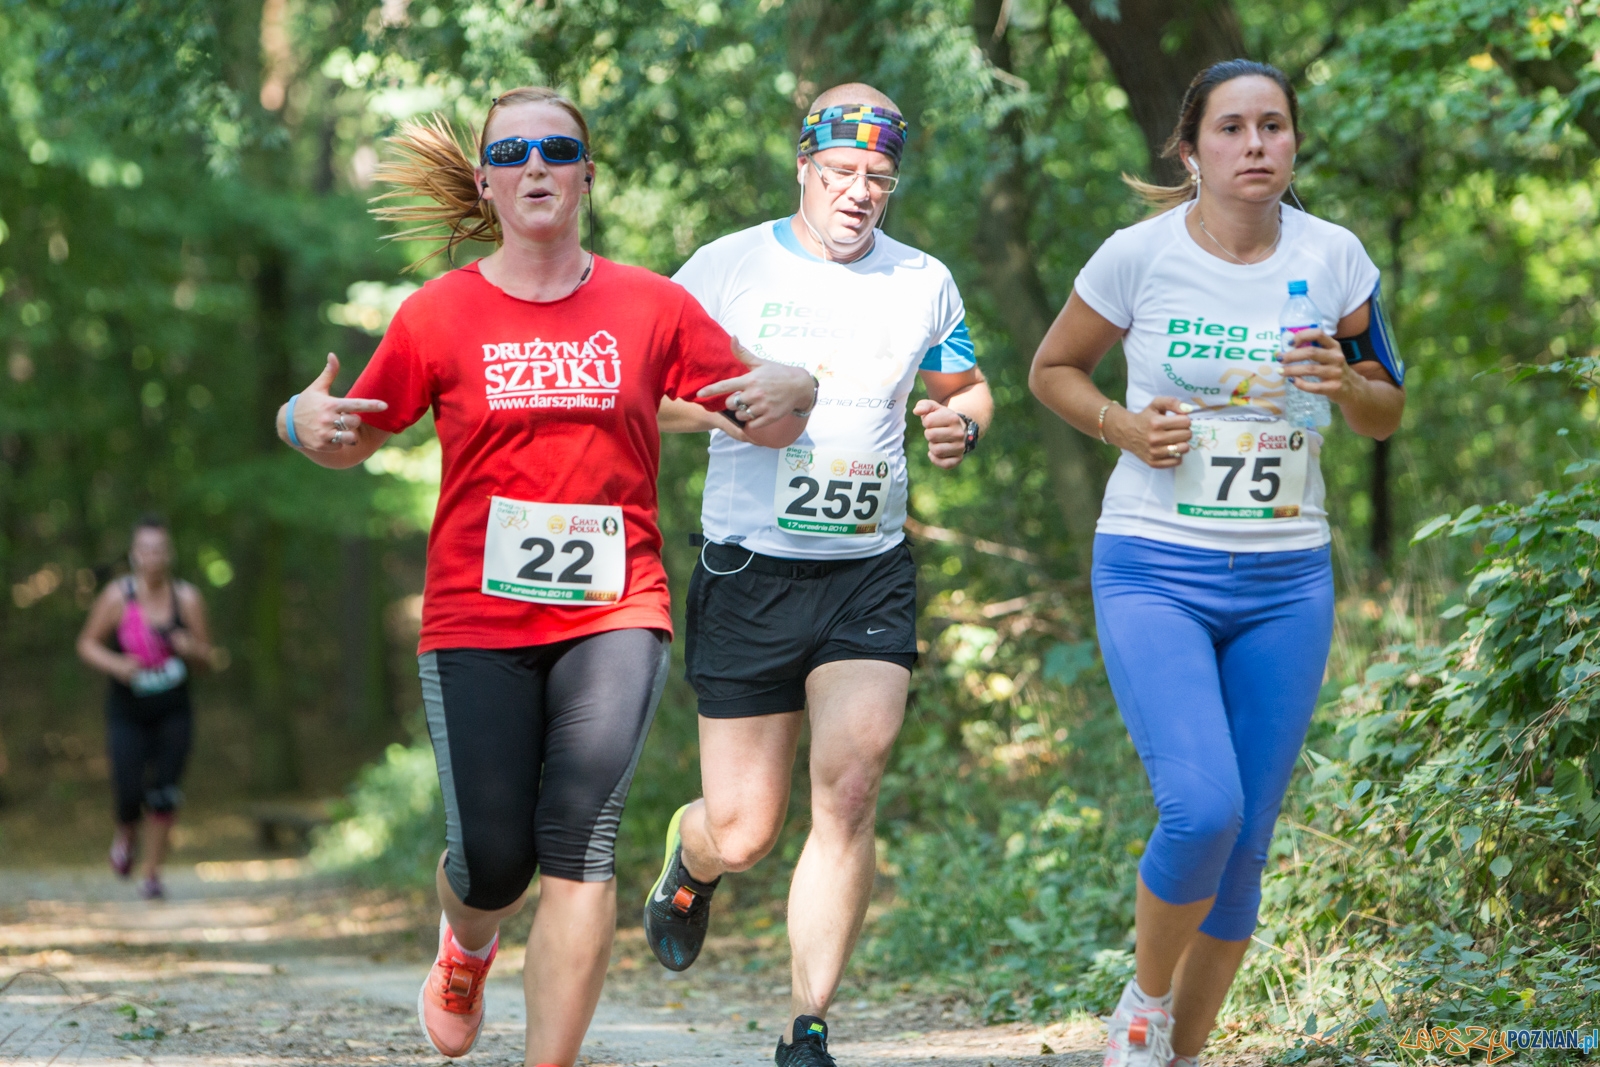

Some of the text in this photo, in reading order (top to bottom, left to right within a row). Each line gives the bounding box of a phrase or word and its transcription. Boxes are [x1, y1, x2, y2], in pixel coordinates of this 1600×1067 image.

[1167, 317, 1249, 342] Bieg
[482, 337, 598, 361] DRUŻYNA
[1167, 340, 1281, 362] Dzieci
[485, 359, 622, 395] SZPIKU
[1161, 363, 1220, 395] Roberta
[488, 394, 615, 411] www.darszpiku.pl
[856, 398, 896, 410] 2016
[849, 469, 875, 477] POLSKA
[1211, 456, 1281, 502] 75
[785, 475, 882, 520] 255
[569, 525, 601, 535] POLSKA
[571, 516, 599, 526] CHATA
[517, 537, 594, 584] 22
[499, 583, 511, 591] 17
[547, 590, 573, 598] 2016
